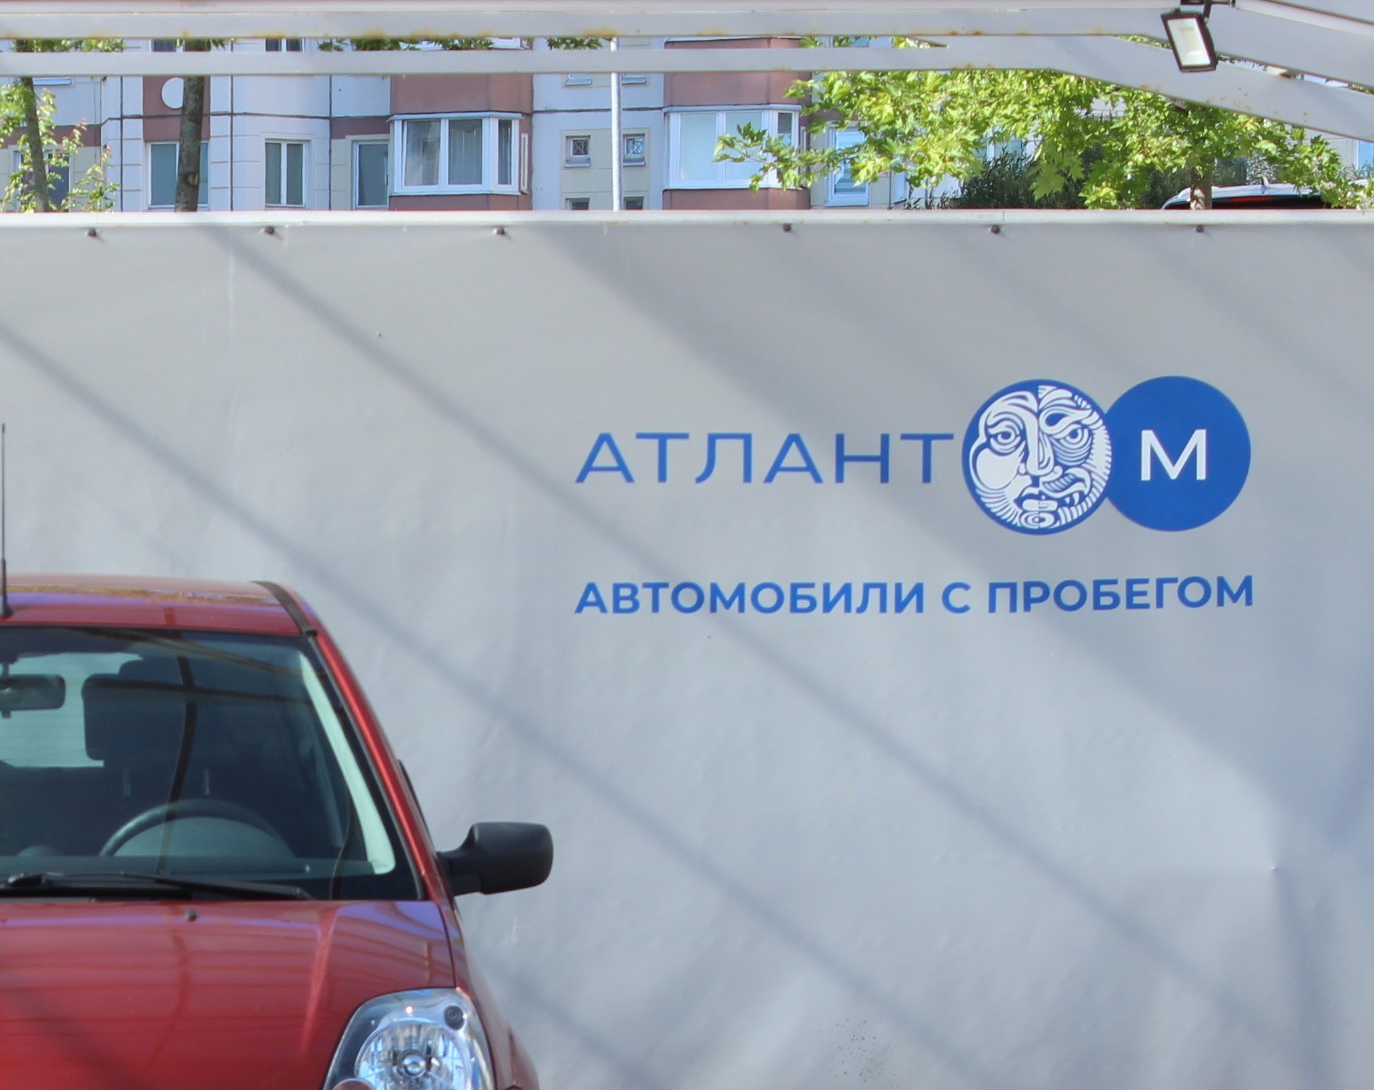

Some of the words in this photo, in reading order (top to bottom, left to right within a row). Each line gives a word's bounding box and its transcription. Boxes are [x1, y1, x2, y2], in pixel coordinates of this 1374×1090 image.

[575, 432, 957, 485] АТЛАНТ
[1140, 428, 1207, 483] М
[574, 580, 928, 616] АВТОМОБИЛИ
[941, 580, 972, 615] С
[987, 575, 1256, 614] ПРОБЕГОМ
